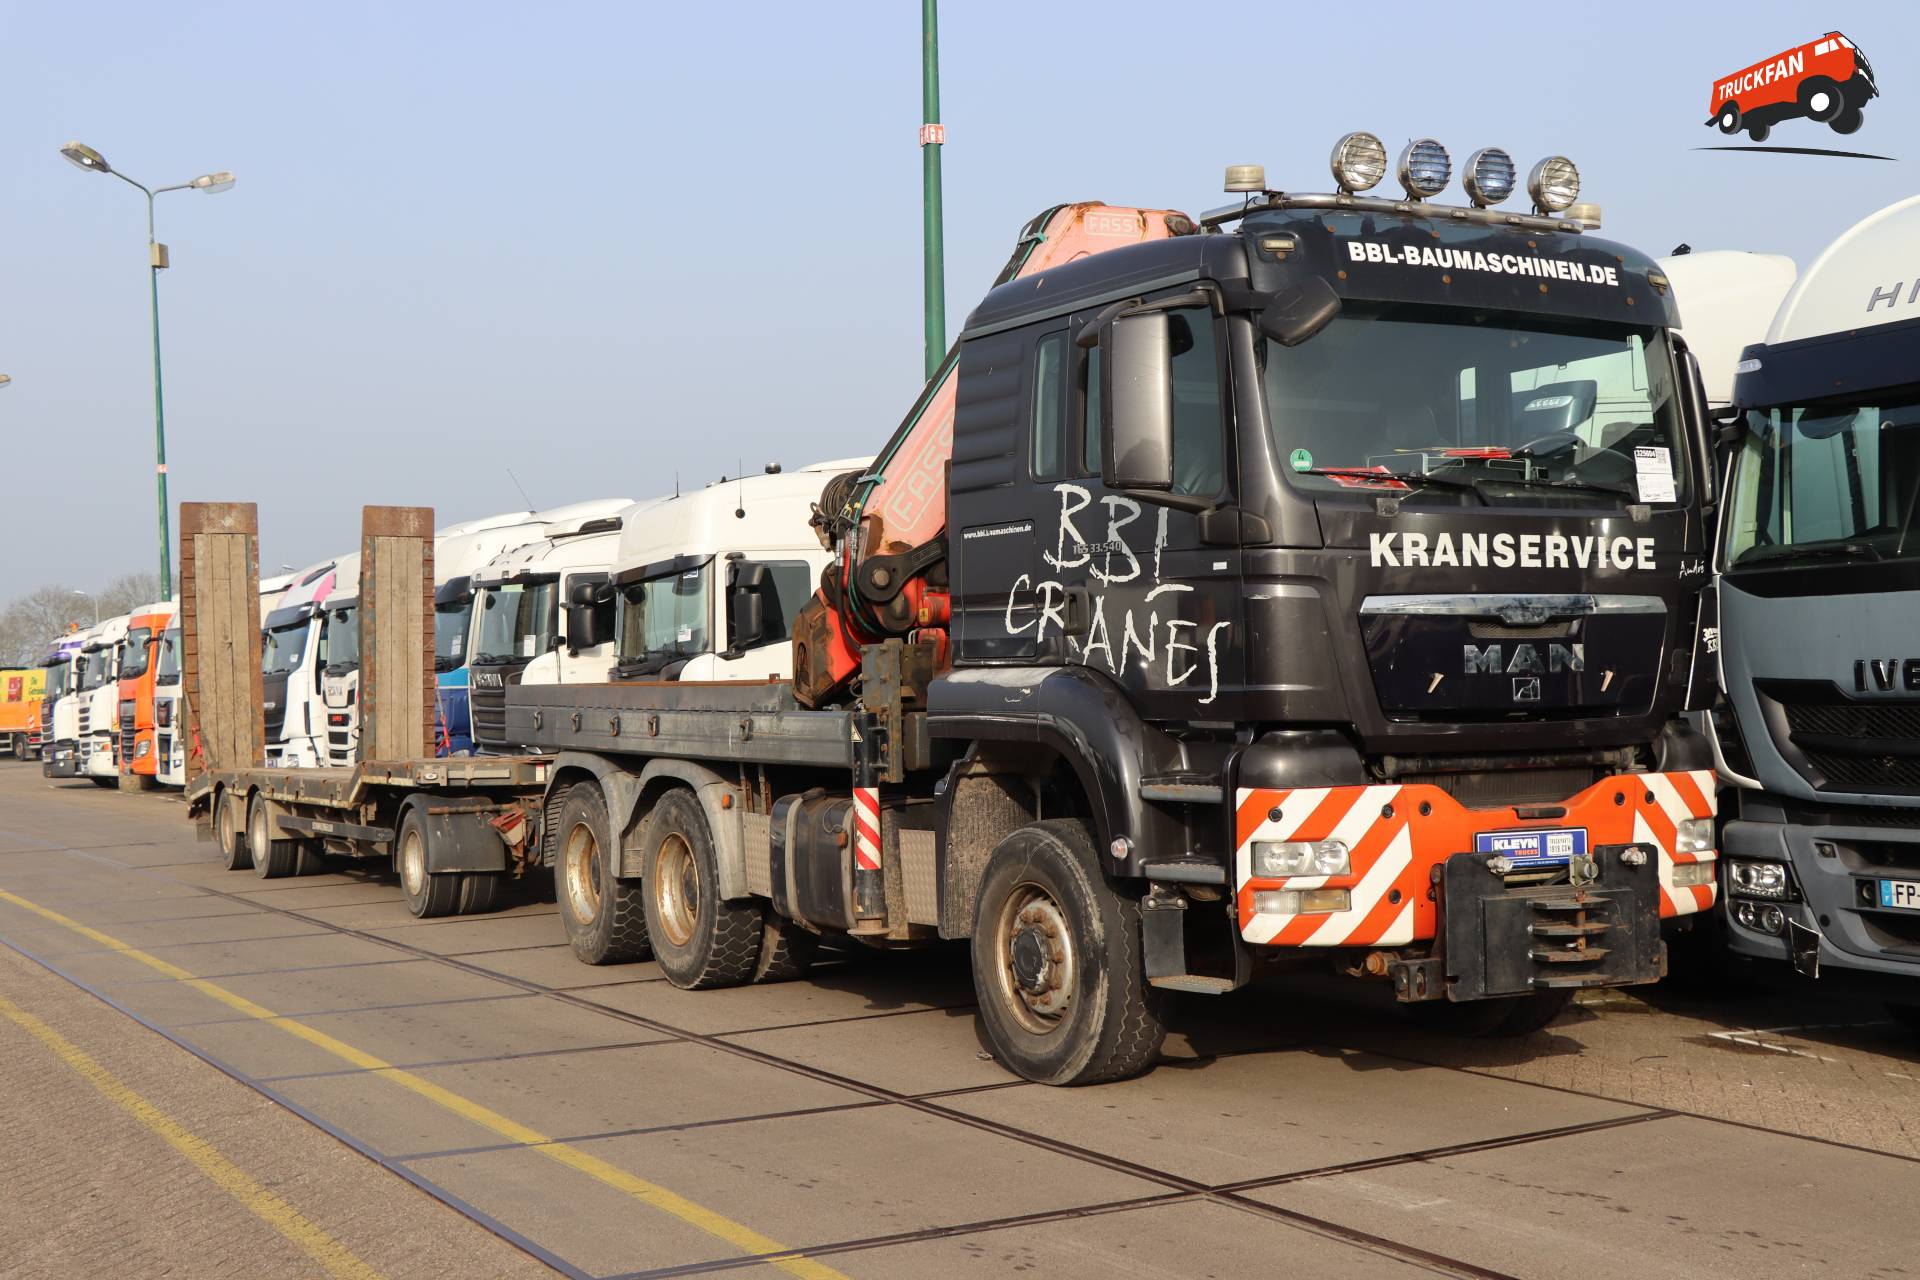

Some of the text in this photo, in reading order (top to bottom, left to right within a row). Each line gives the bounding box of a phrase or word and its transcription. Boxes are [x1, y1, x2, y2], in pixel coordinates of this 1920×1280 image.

[1088, 216, 1139, 235] FASSI
[1347, 241, 1620, 287] BBL-BAUMASCHINEN.DE
[1090, 541, 1122, 554] 33.540
[1369, 532, 1657, 570] KRANSERVICE
[1464, 643, 1585, 674] MAN
[1493, 838, 1538, 851] KLEYN
